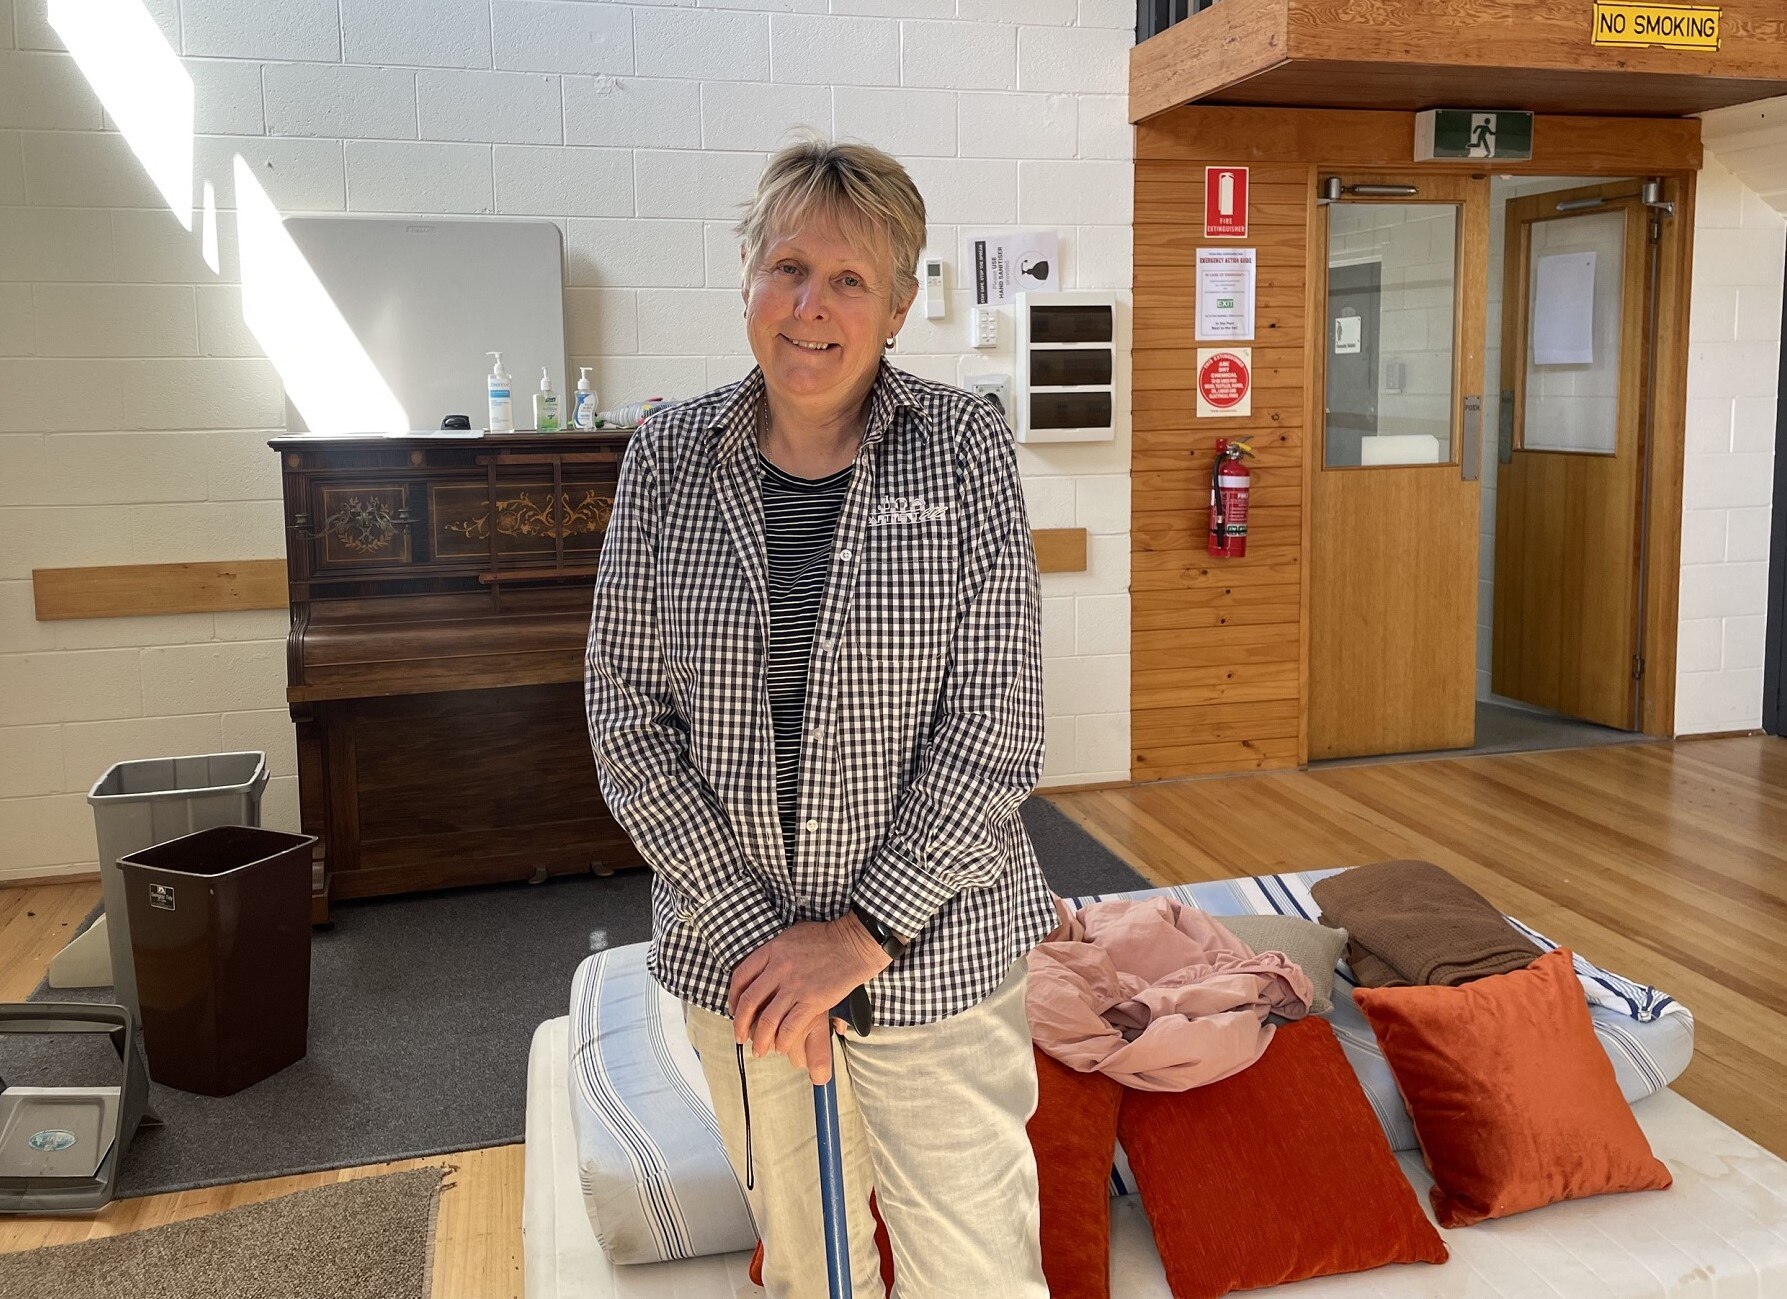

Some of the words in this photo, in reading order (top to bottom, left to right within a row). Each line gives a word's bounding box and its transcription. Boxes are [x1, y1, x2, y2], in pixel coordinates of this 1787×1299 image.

[1600, 12, 1626, 34] NO
[1634, 14, 1715, 38] SMOKING
[1219, 217, 1233, 225] FIRE
[1207, 225, 1245, 233] EXTINGUISHER
[1218, 300, 1233, 308] EXIT
